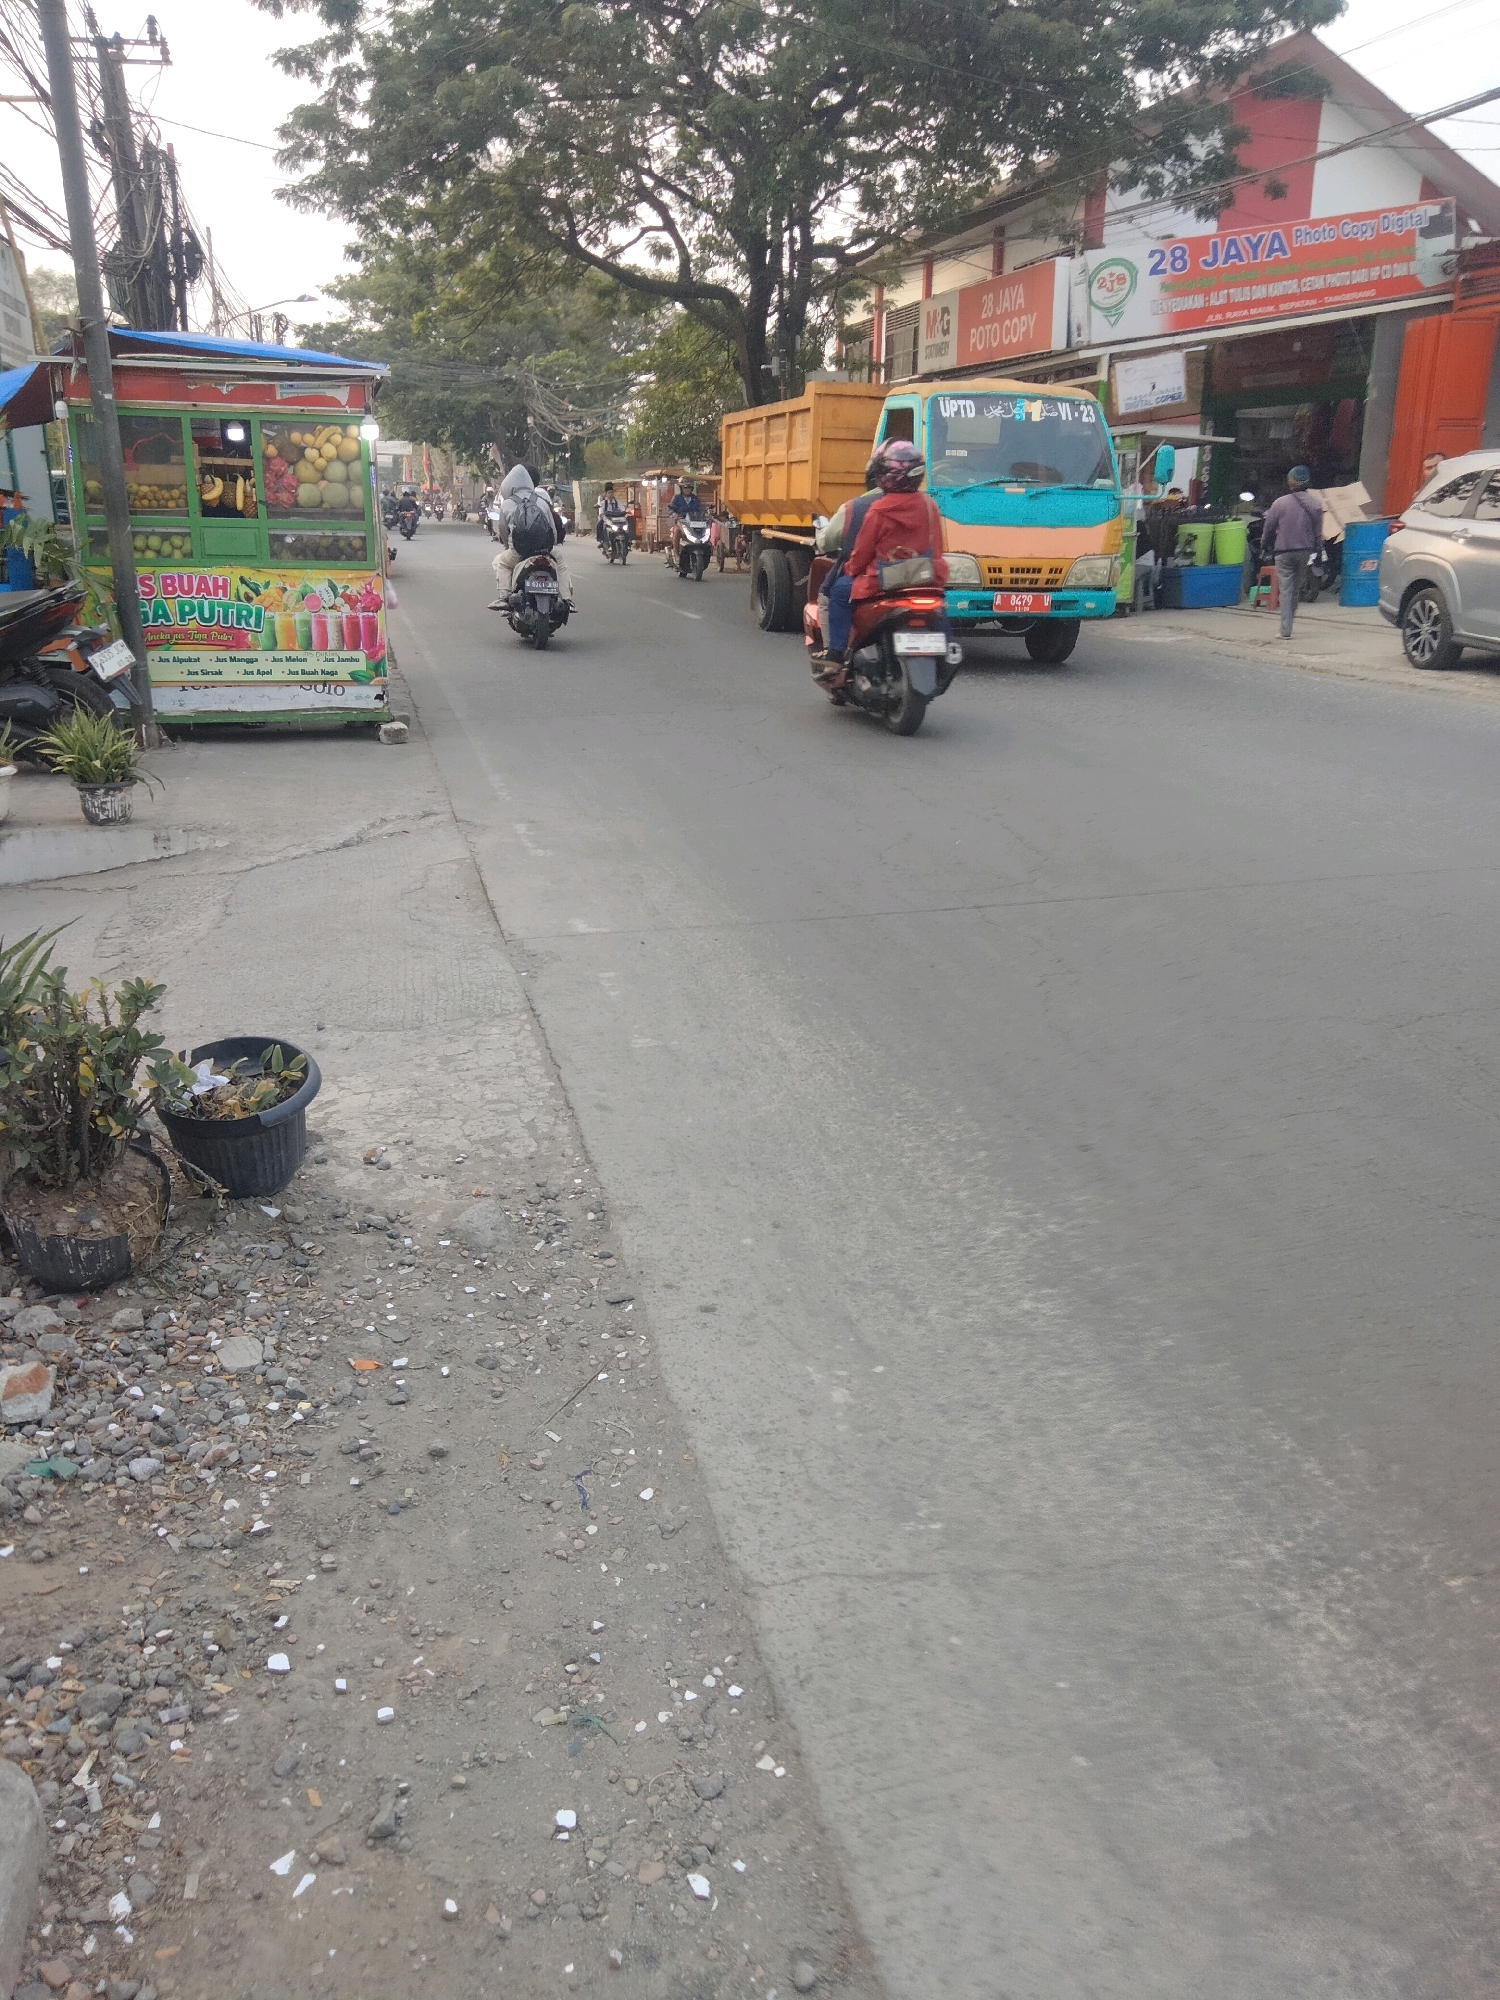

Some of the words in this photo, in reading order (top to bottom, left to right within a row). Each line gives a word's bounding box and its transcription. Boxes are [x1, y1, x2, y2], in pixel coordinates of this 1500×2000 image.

[1292, 223, 1337, 248] Photo
[1339, 218, 1379, 242] Copy
[1379, 208, 1430, 236] Digital
[1147, 244, 1189, 277] 28
[1200, 229, 1291, 270] JAYA
[981, 292, 994, 320] 28
[996, 283, 1025, 316] JAYA
[1225, 308, 1250, 320] RAYA
[1323, 288, 1377, 305] TANGERANG
[925, 306, 951, 340] M&G
[969, 322, 1001, 352] POTO
[1002, 312, 1038, 345] COPY
[938, 397, 976, 418] UPTD
[1081, 404, 1096, 424] 23
[160, 572, 231, 600] BUAH
[995, 594, 1002, 606] A
[1010, 594, 1033, 606] 8479
[175, 598, 265, 633] PUTRI
[145, 632, 171, 641] Aneka
[168, 632, 185, 644] jus
[210, 631, 234, 641] Putri
[172, 656, 200, 664] Alpukat
[229, 656, 259, 664] Mangga
[256, 669, 273, 677] Apel
[320, 669, 338, 677] Naga
